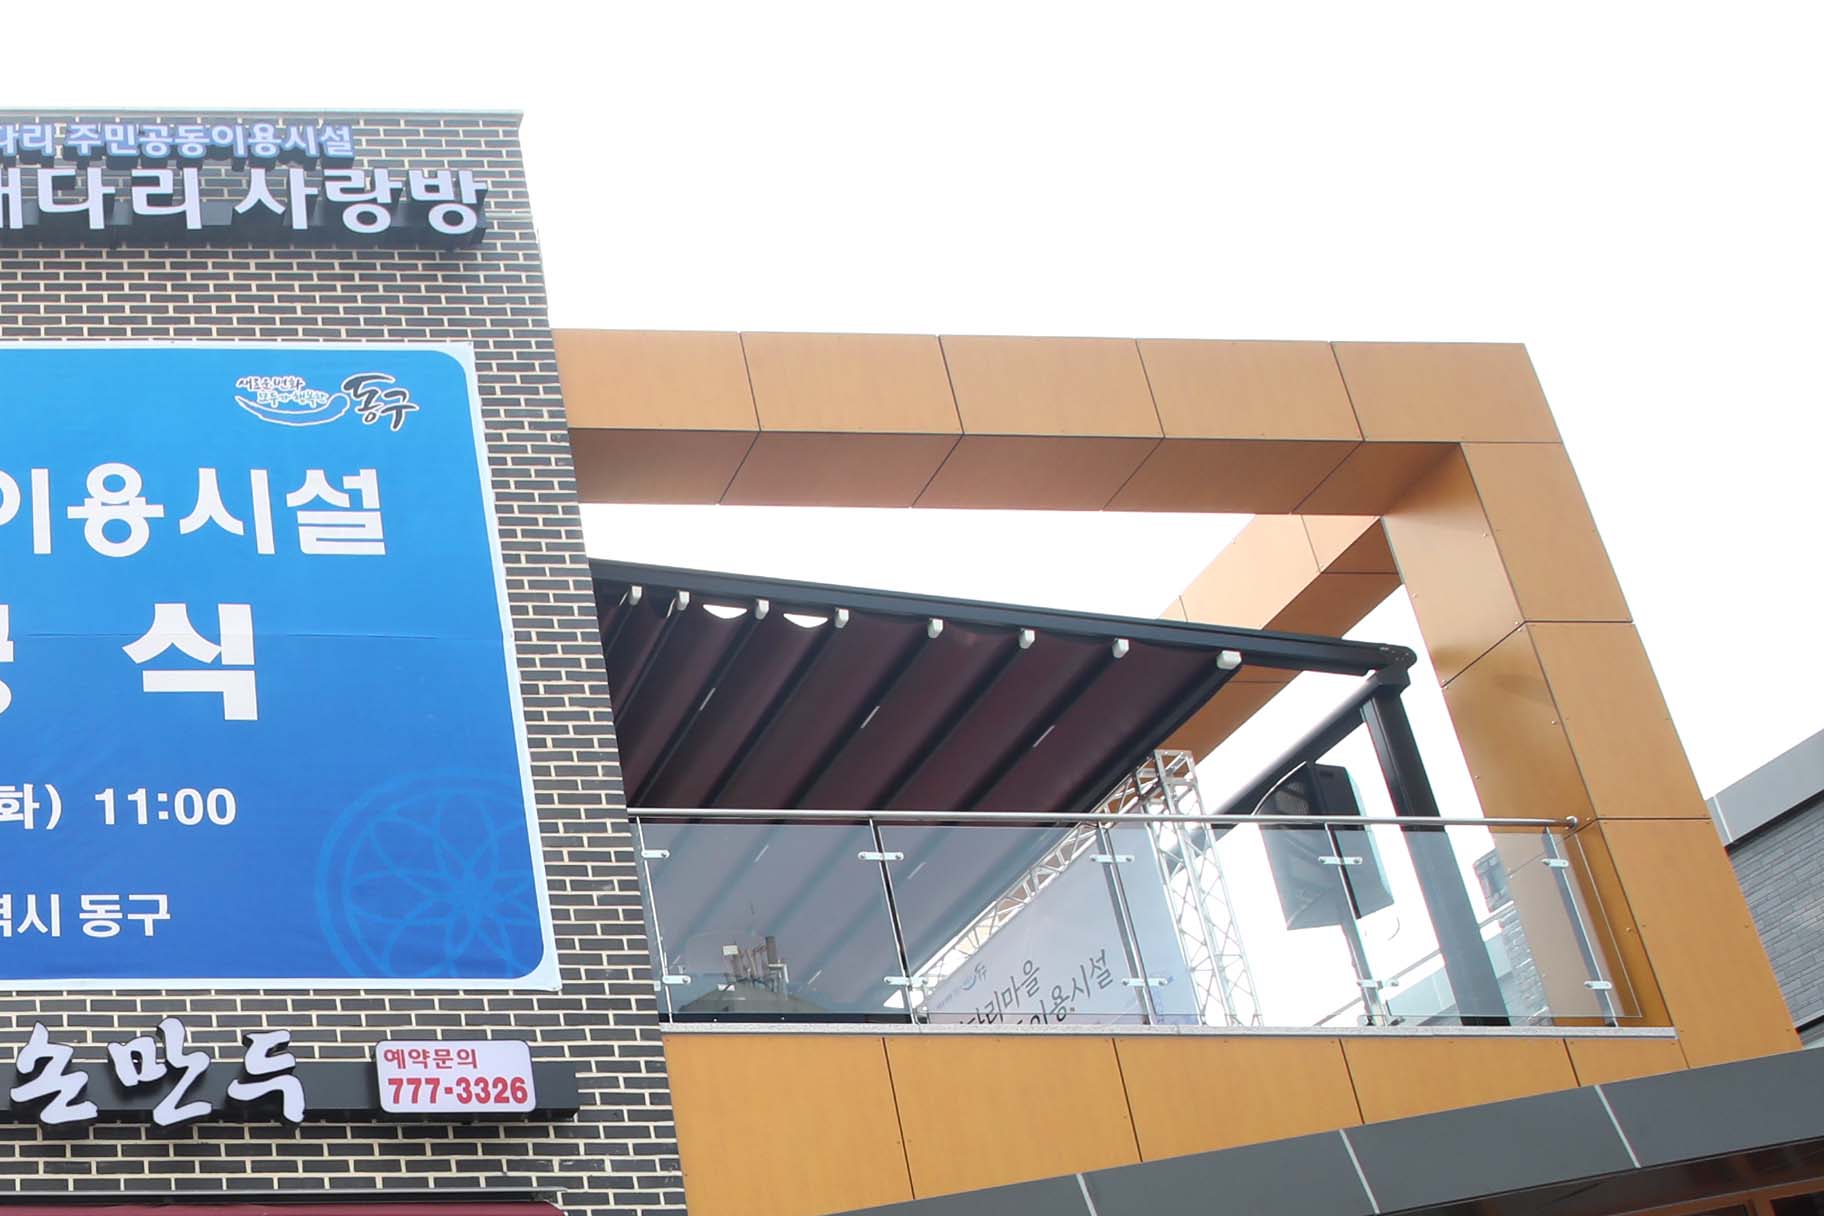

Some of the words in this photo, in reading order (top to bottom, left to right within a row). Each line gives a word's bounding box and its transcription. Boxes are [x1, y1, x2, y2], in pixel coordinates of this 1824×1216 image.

[63, 123, 354, 159] 주민공동이용시설
[234, 168, 487, 234] 사랑방
[342, 373, 419, 431] 동구
[94, 788, 236, 826] 11:00
[79, 894, 171, 938] 동구
[10, 1017, 305, 1127] 손만두
[383, 1048, 478, 1069] 예약문의
[388, 1077, 527, 1104] 777-3326
